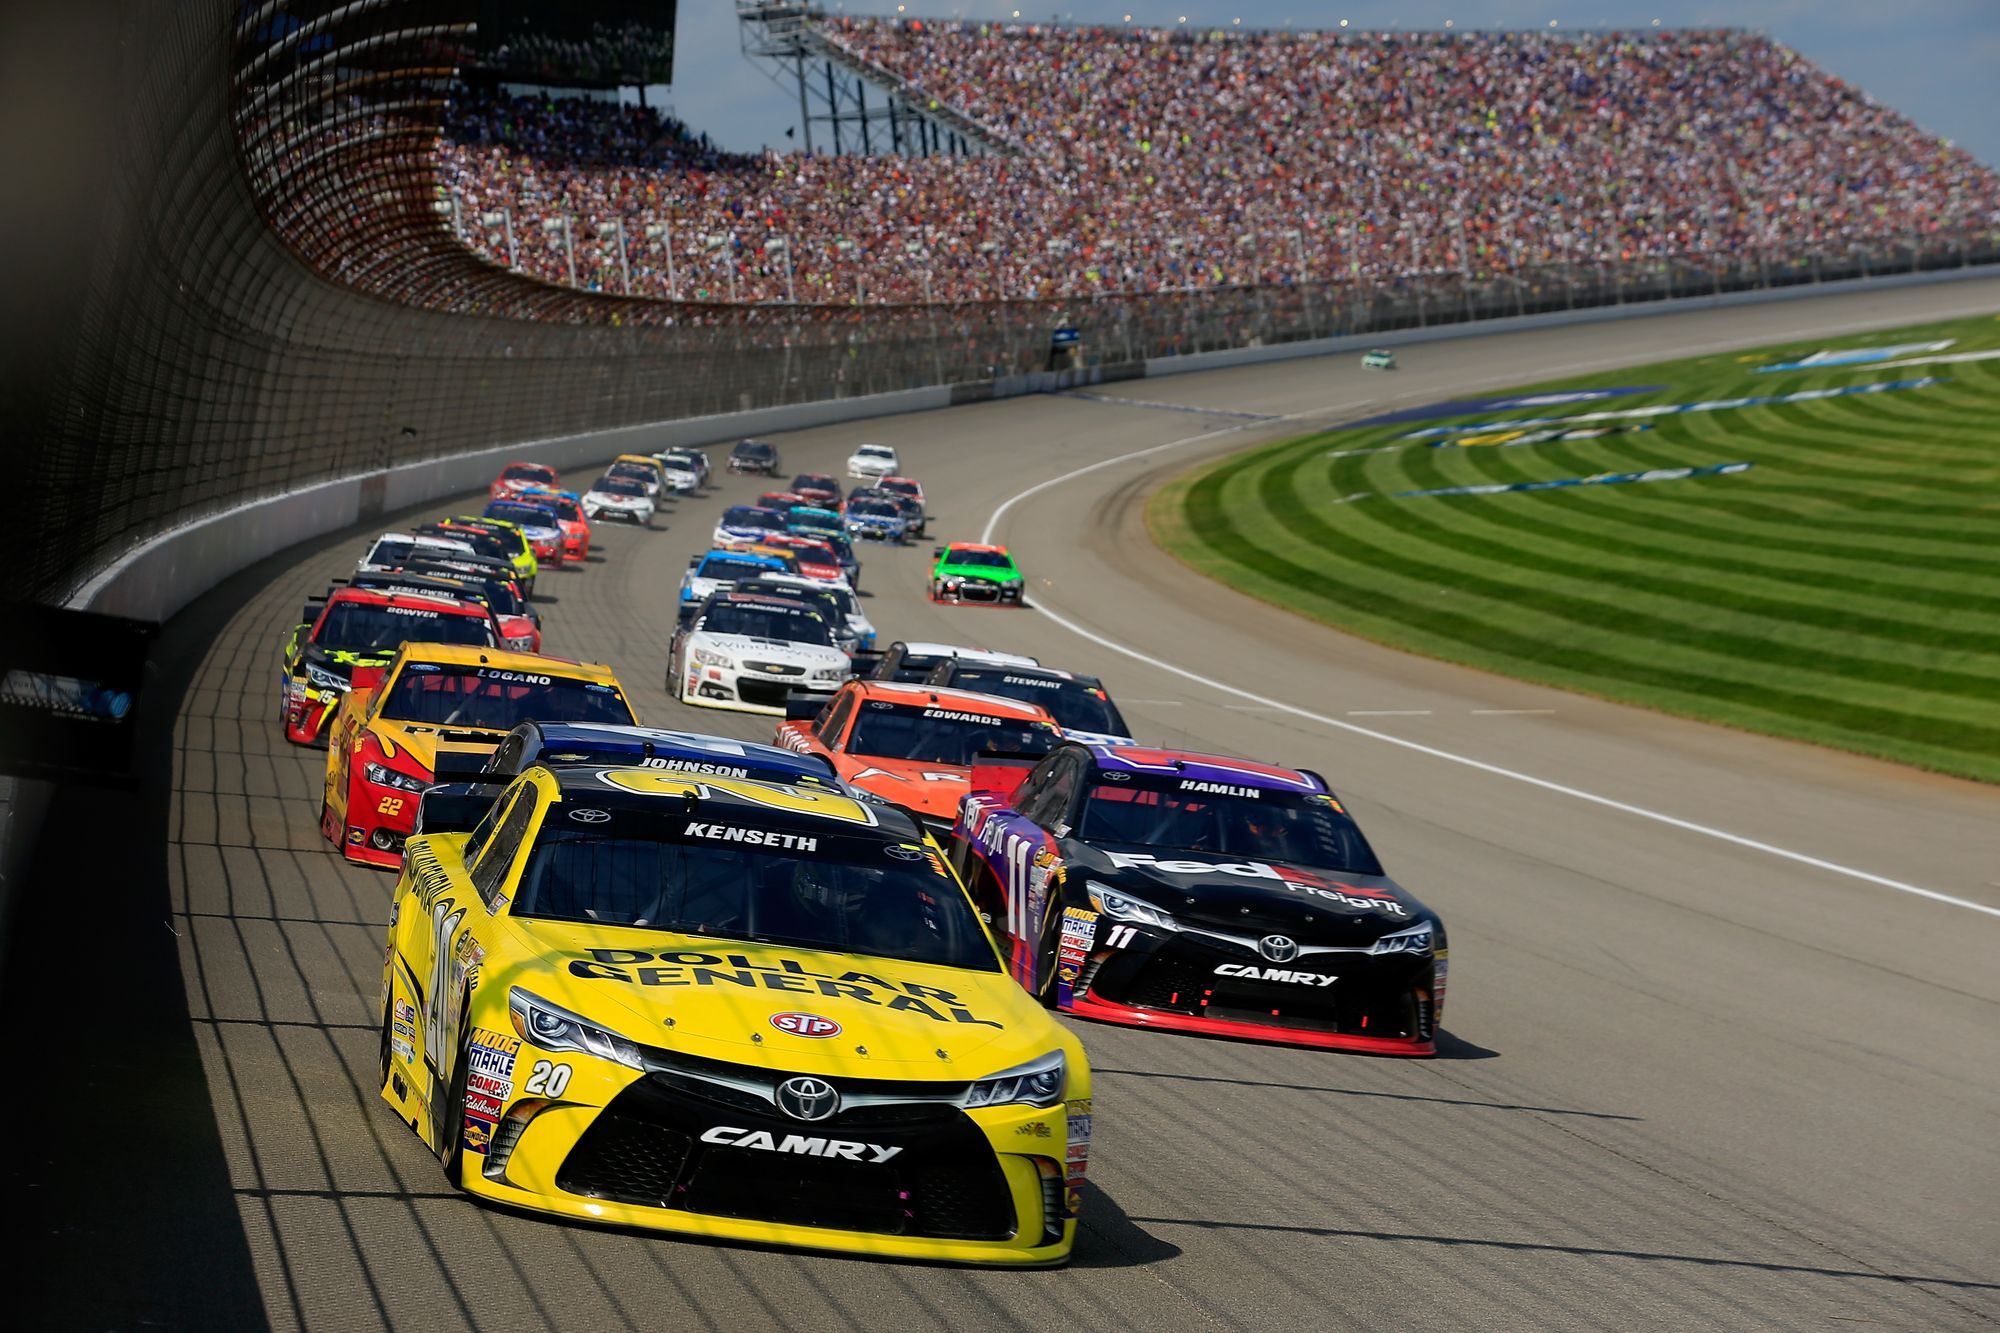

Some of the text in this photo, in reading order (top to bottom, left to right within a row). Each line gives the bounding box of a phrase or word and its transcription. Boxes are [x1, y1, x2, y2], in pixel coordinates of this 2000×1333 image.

[387, 584, 455, 599] KESELOWSKI
[386, 605, 439, 619] BOWYER
[711, 639, 812, 659] Windows
[476, 667, 551, 687] LOGANO
[1003, 675, 1063, 689] STEWART
[317, 689, 336, 704] 15
[922, 708, 1002, 726] EDWARDS
[638, 756, 749, 779] JOHNSON
[1180, 779, 1260, 799] HAMLIN
[377, 796, 404, 817] 22
[684, 822, 818, 852] KENSETH
[1102, 849, 1398, 902] FedEx
[1282, 881, 1409, 917] Freight
[1062, 906, 1100, 923] MOOG
[1064, 918, 1096, 937] MAHLE
[1105, 924, 1139, 950] 11
[583, 947, 967, 1007] DOLLAR
[1213, 963, 1340, 988] CAMRY
[568, 959, 1004, 1031] GENERAL
[779, 1013, 835, 1036] STP
[471, 1028, 521, 1054] MOOG
[469, 1048, 516, 1078] MAHLE
[468, 1073, 501, 1093] COMP
[524, 1059, 574, 1099] 20
[465, 1093, 500, 1118] Edelbrock
[463, 1129, 489, 1145] SUNOCO
[700, 1125, 905, 1163] CAMRY
